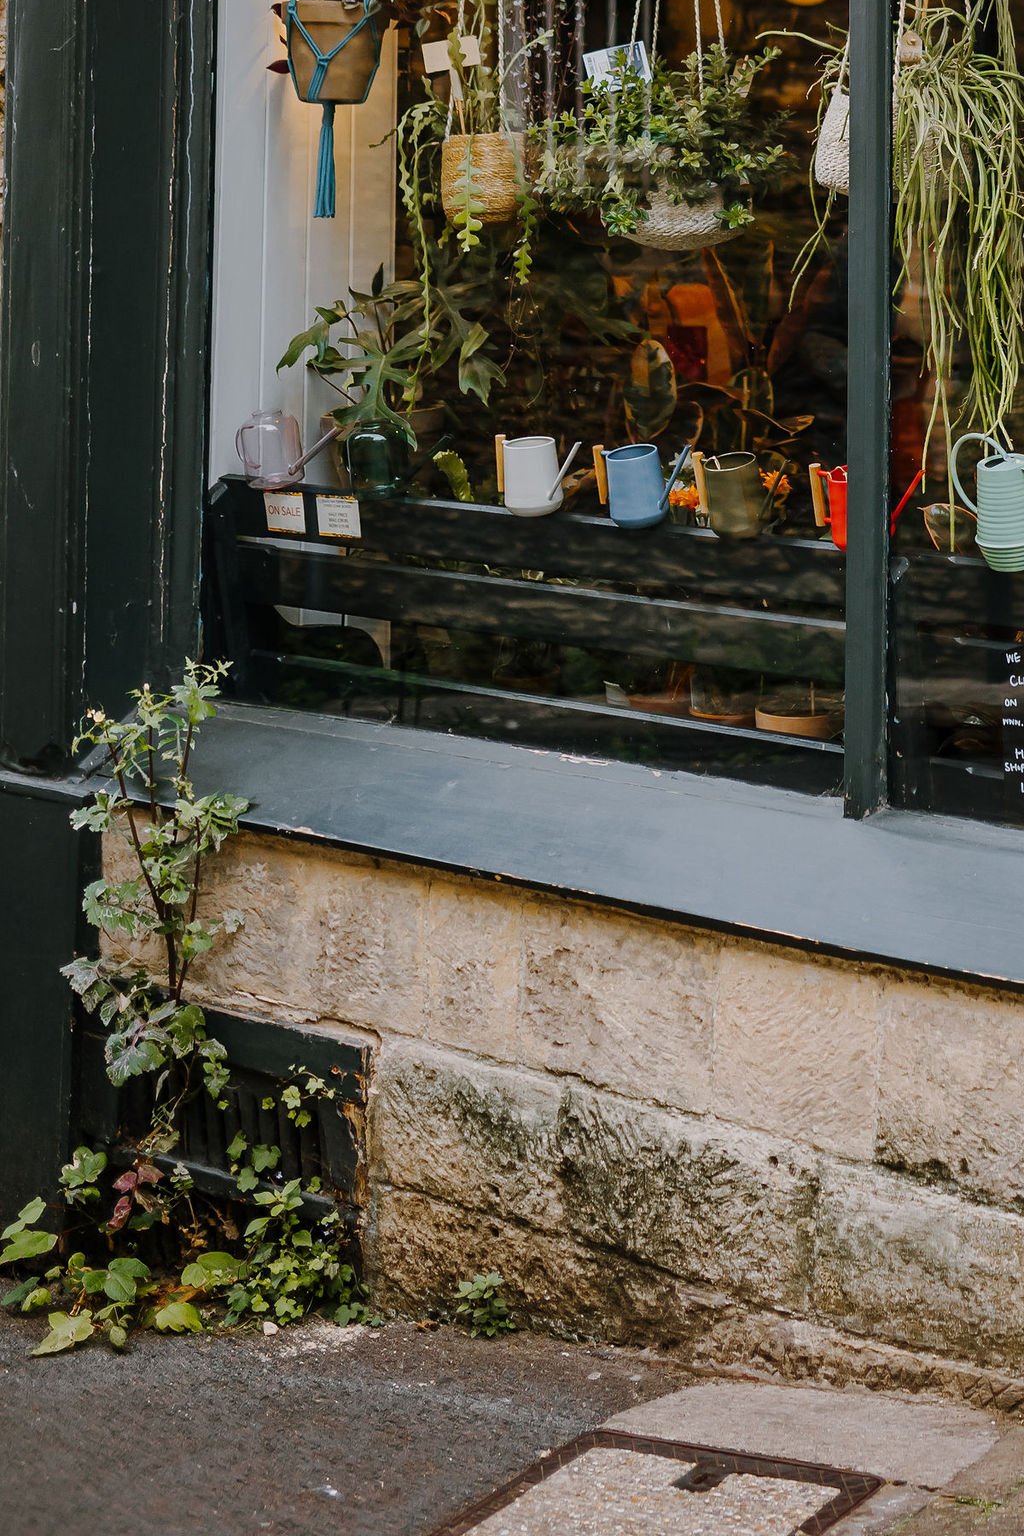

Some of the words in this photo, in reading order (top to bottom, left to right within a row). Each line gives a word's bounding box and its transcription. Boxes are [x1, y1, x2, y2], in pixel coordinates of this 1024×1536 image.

[268, 504, 280, 515] ON
[282, 505, 301, 517] SALE
[1006, 652, 1021, 664] WE
[1004, 698, 1018, 707] ON
